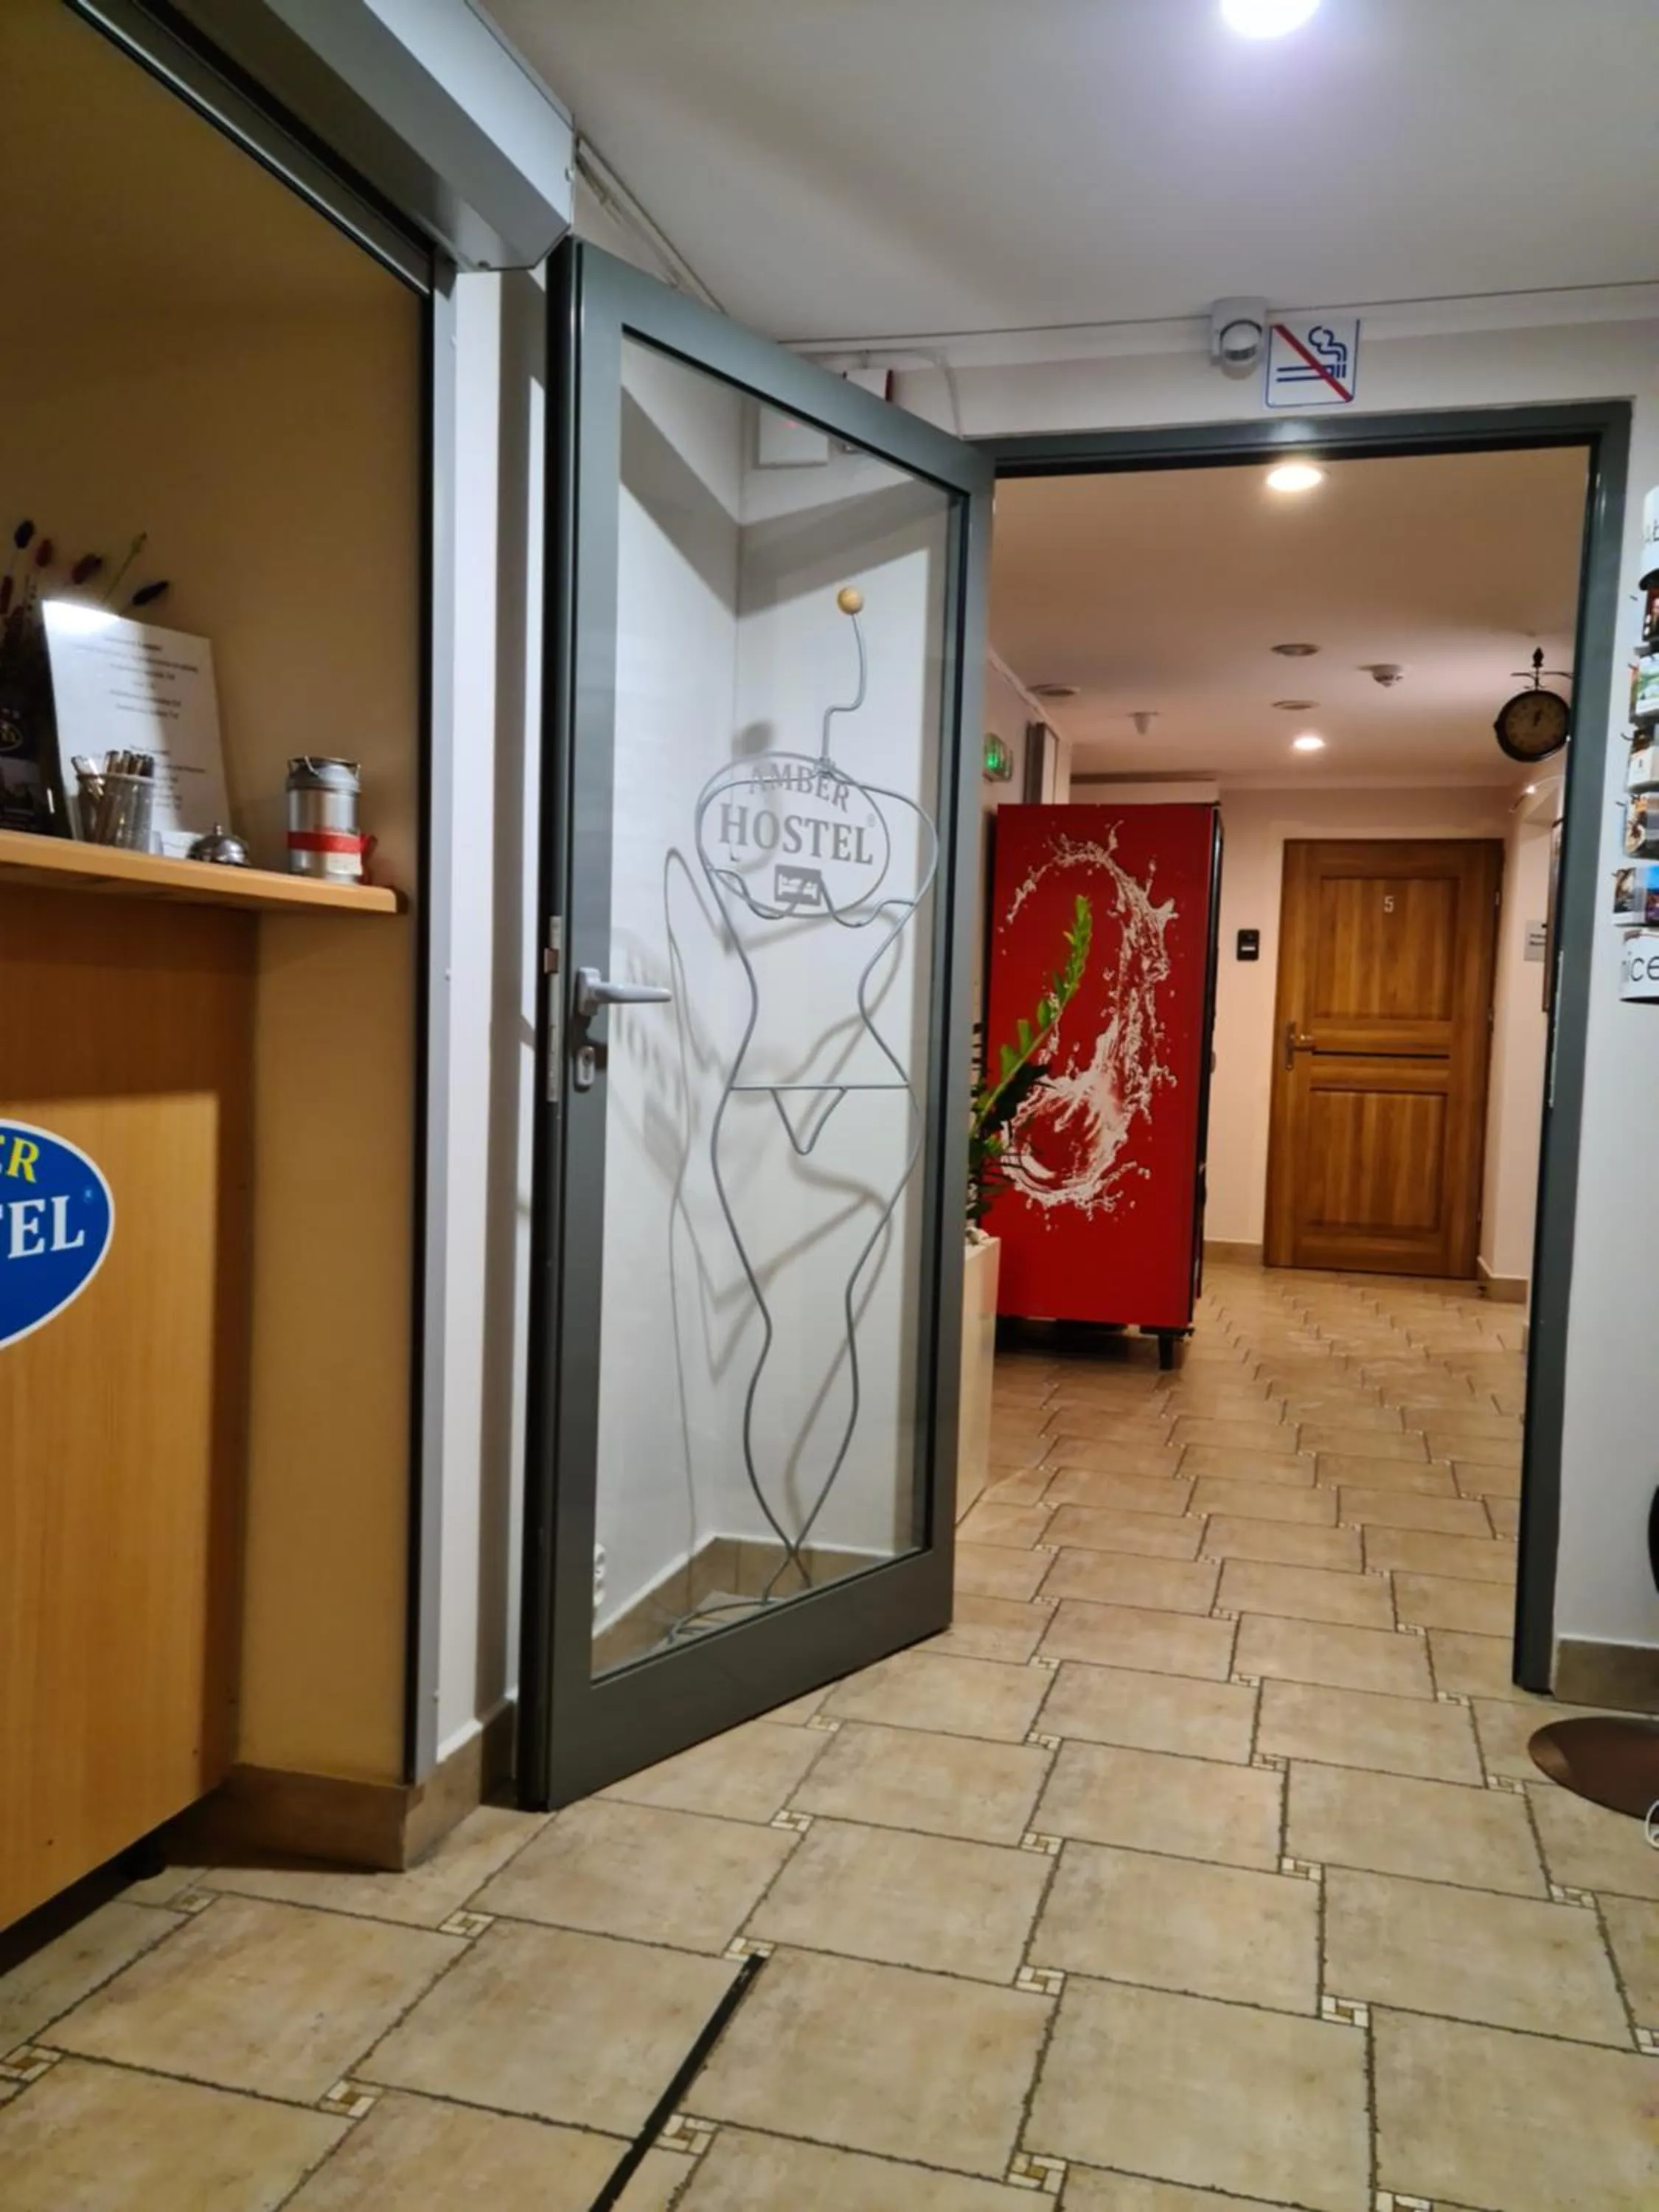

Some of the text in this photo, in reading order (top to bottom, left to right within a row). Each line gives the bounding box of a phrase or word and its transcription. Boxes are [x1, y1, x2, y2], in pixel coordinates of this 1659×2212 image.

[748, 762, 849, 812] AMBER
[719, 802, 873, 865] HOSTEL
[1383, 895, 1394, 913] 5
[0, 1135, 39, 1183] R
[0, 1195, 85, 1259] EL
